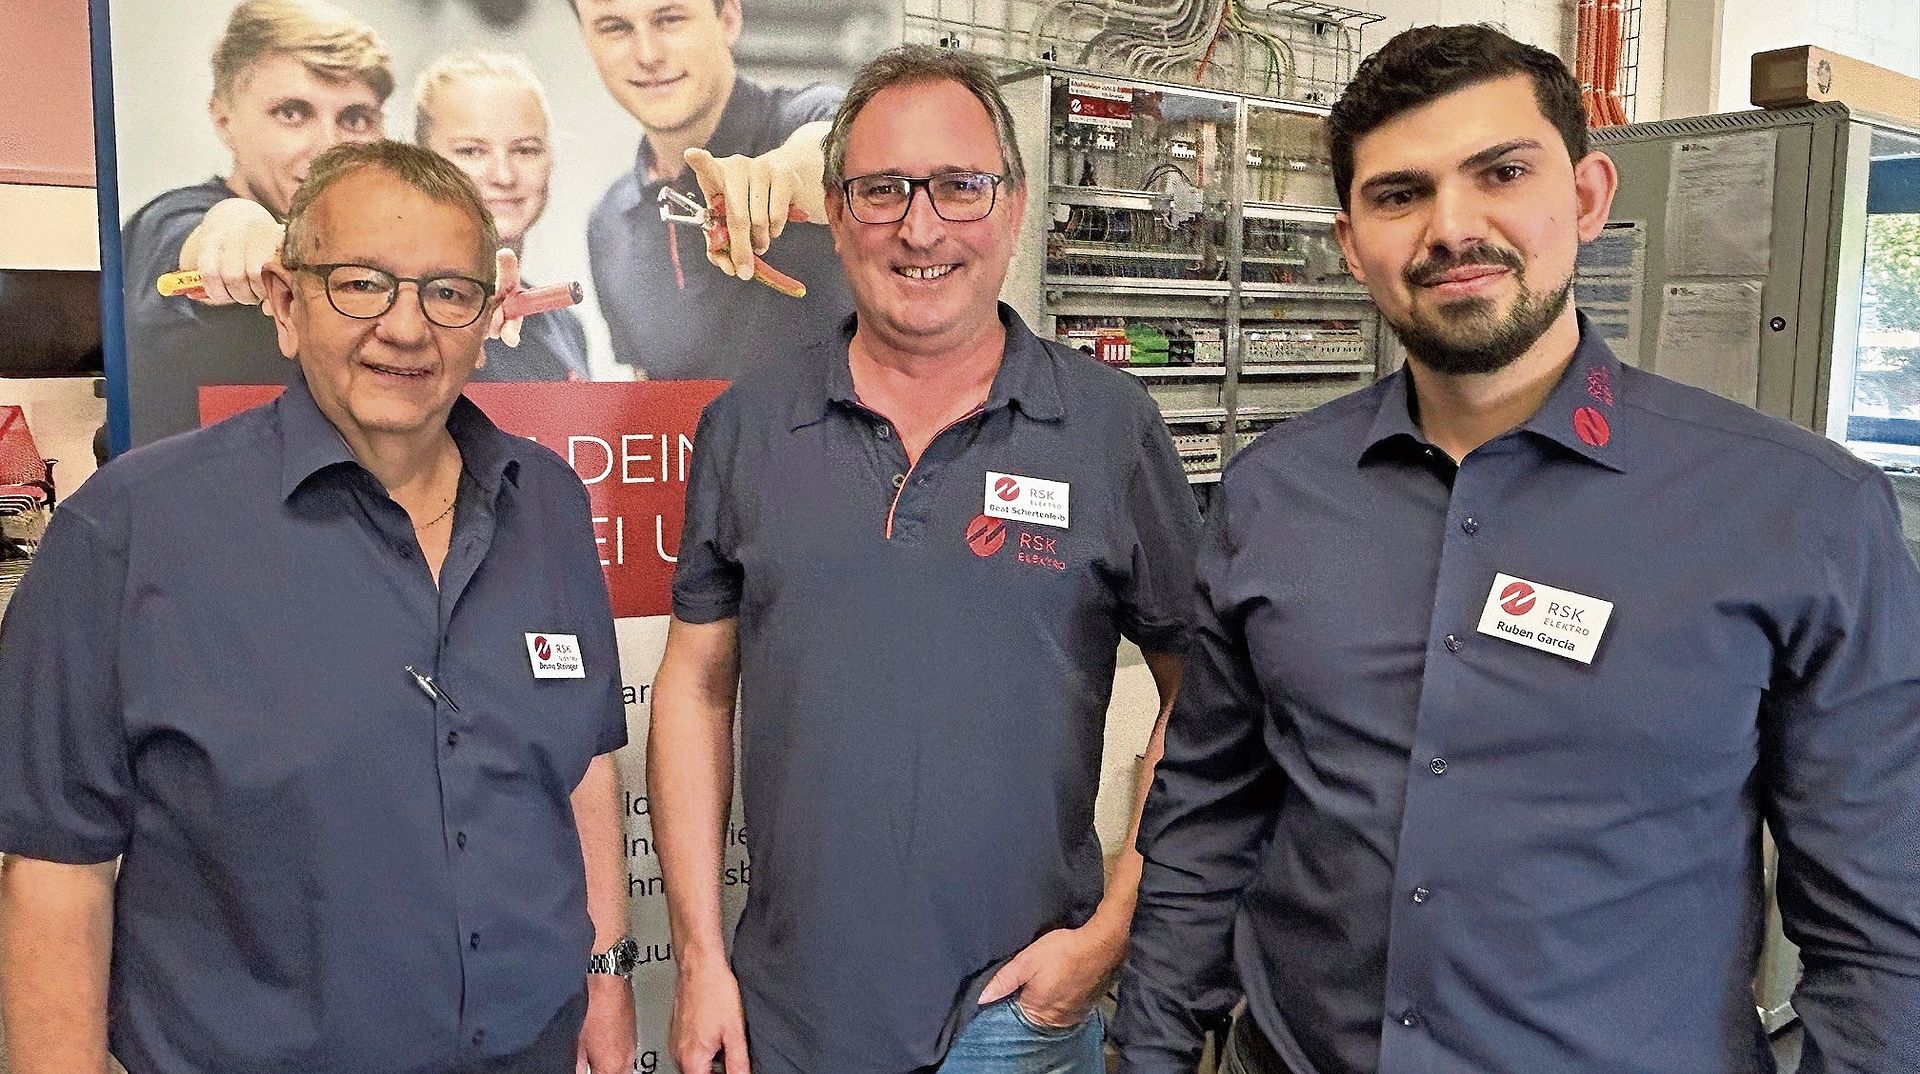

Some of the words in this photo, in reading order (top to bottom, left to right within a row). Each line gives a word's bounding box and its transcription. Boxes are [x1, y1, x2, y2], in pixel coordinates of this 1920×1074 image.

[1029, 488, 1055, 501] RSK
[1019, 532, 1057, 555] RSK
[1548, 602, 1585, 622] RSK
[1496, 621, 1534, 640] Ruben
[1537, 632, 1576, 652] Garcia
[1543, 617, 1590, 636] ELEKTRO
